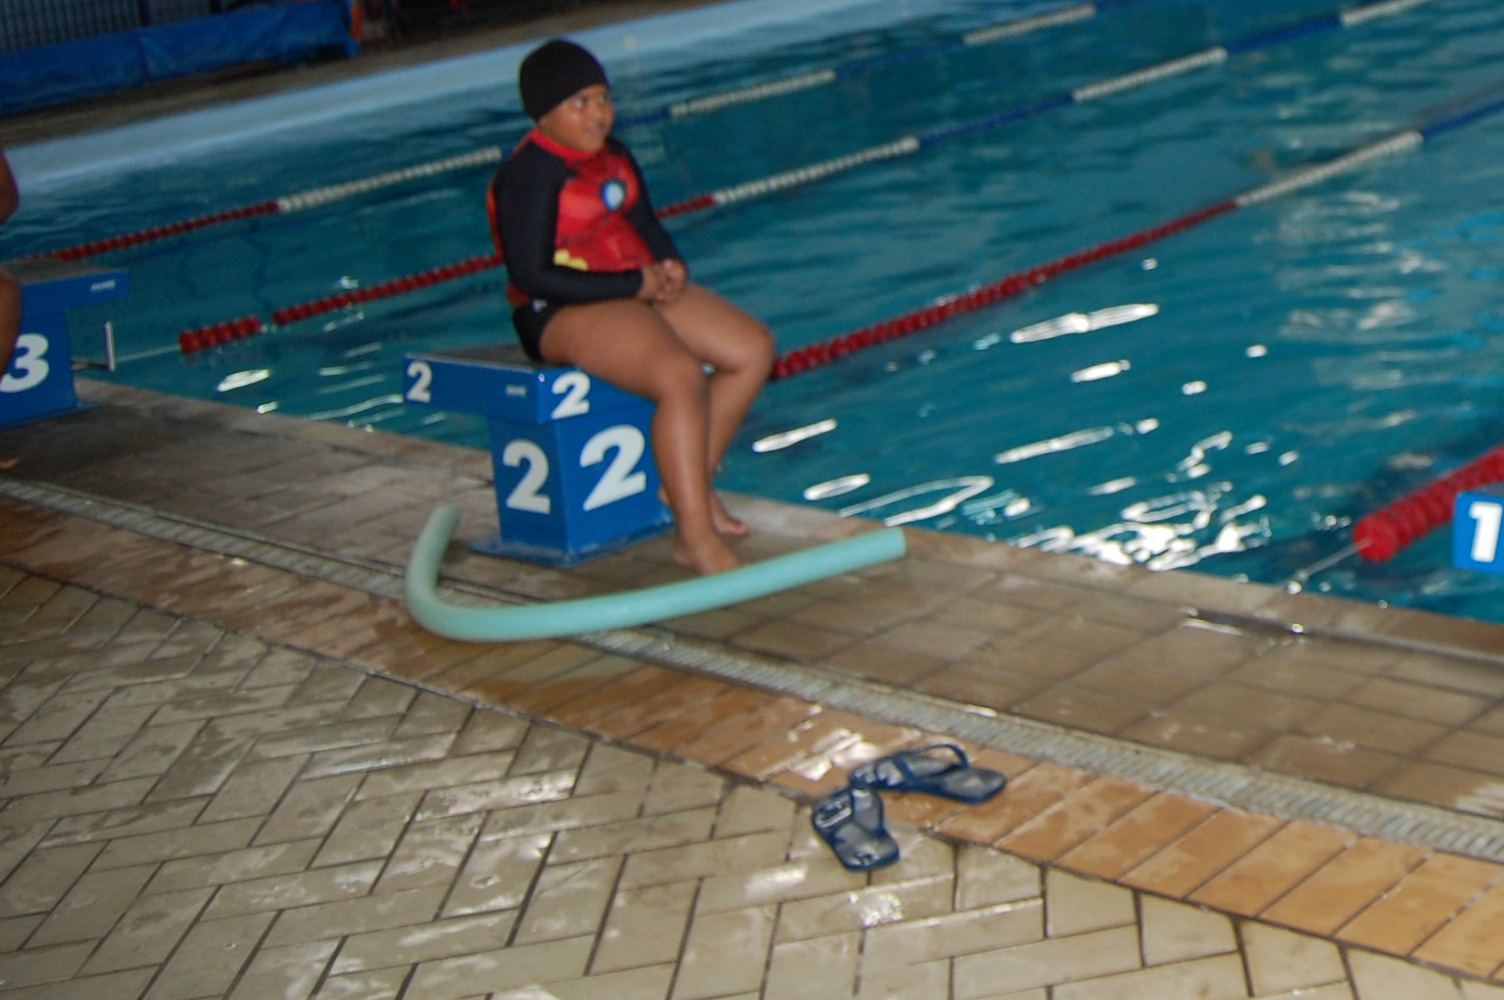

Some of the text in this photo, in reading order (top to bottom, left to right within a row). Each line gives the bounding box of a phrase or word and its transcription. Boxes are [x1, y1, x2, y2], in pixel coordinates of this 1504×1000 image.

[0, 333, 49, 392] 3
[407, 361, 433, 403] 2
[551, 371, 591, 419] 2
[503, 439, 550, 514] 2
[579, 424, 647, 511] 2
[1469, 501, 1503, 562] 1
